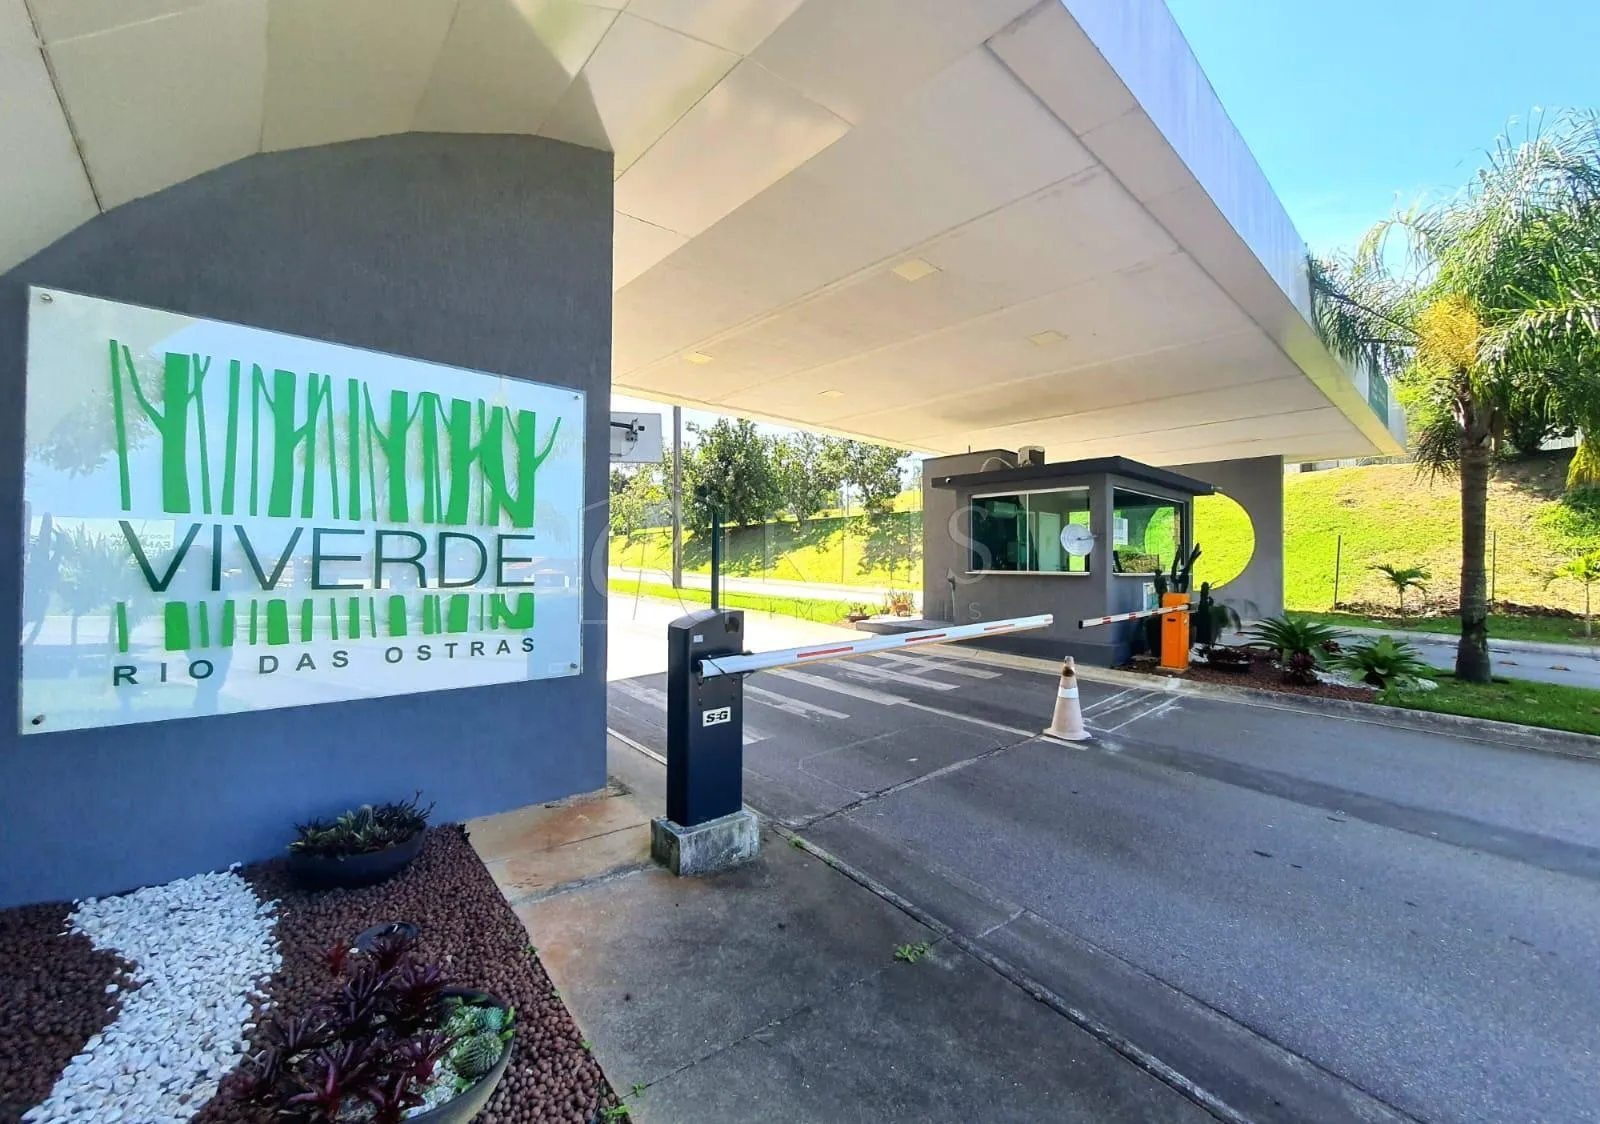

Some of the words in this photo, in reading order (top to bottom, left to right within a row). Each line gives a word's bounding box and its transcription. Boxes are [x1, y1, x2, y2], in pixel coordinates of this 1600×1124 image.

[118, 520, 535, 592] VIVERDE
[113, 660, 215, 687] RIO
[259, 650, 350, 674] DAS
[385, 637, 535, 663] OSTRAS
